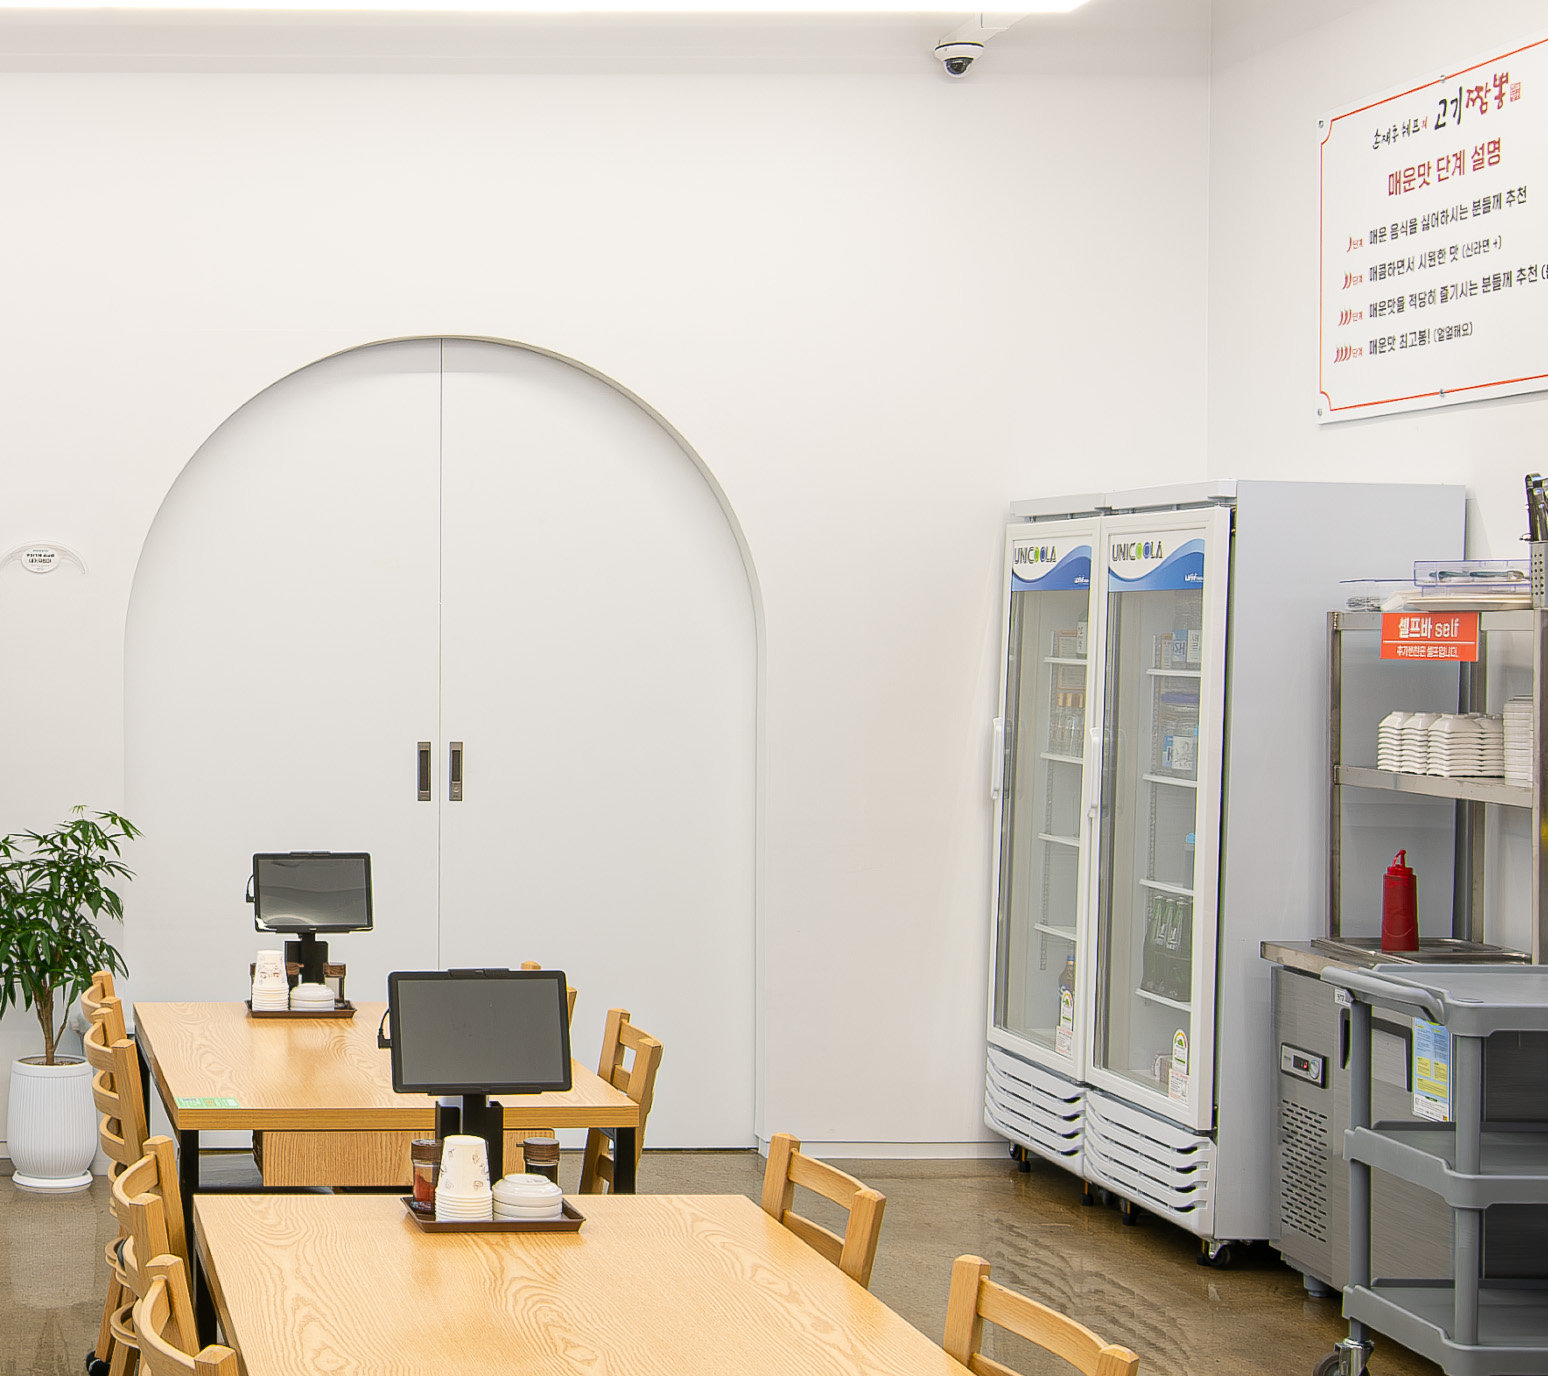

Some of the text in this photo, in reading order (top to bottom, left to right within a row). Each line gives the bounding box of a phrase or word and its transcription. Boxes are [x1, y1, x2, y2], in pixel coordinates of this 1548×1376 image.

[1388, 136, 1501, 197] 매운맛 단계 설명
[1369, 226, 1388, 246] 매운
[1471, 192, 1503, 217] 분들께
[1505, 185, 1527, 207] 추천
[1418, 247, 1447, 271] 시원한
[1449, 243, 1459, 263] 맛
[1481, 270, 1513, 294] 분들께
[1516, 263, 1538, 286] 추천
[1369, 336, 1396, 356] 매운맛
[1398, 616, 1460, 639] 셀프바 self
